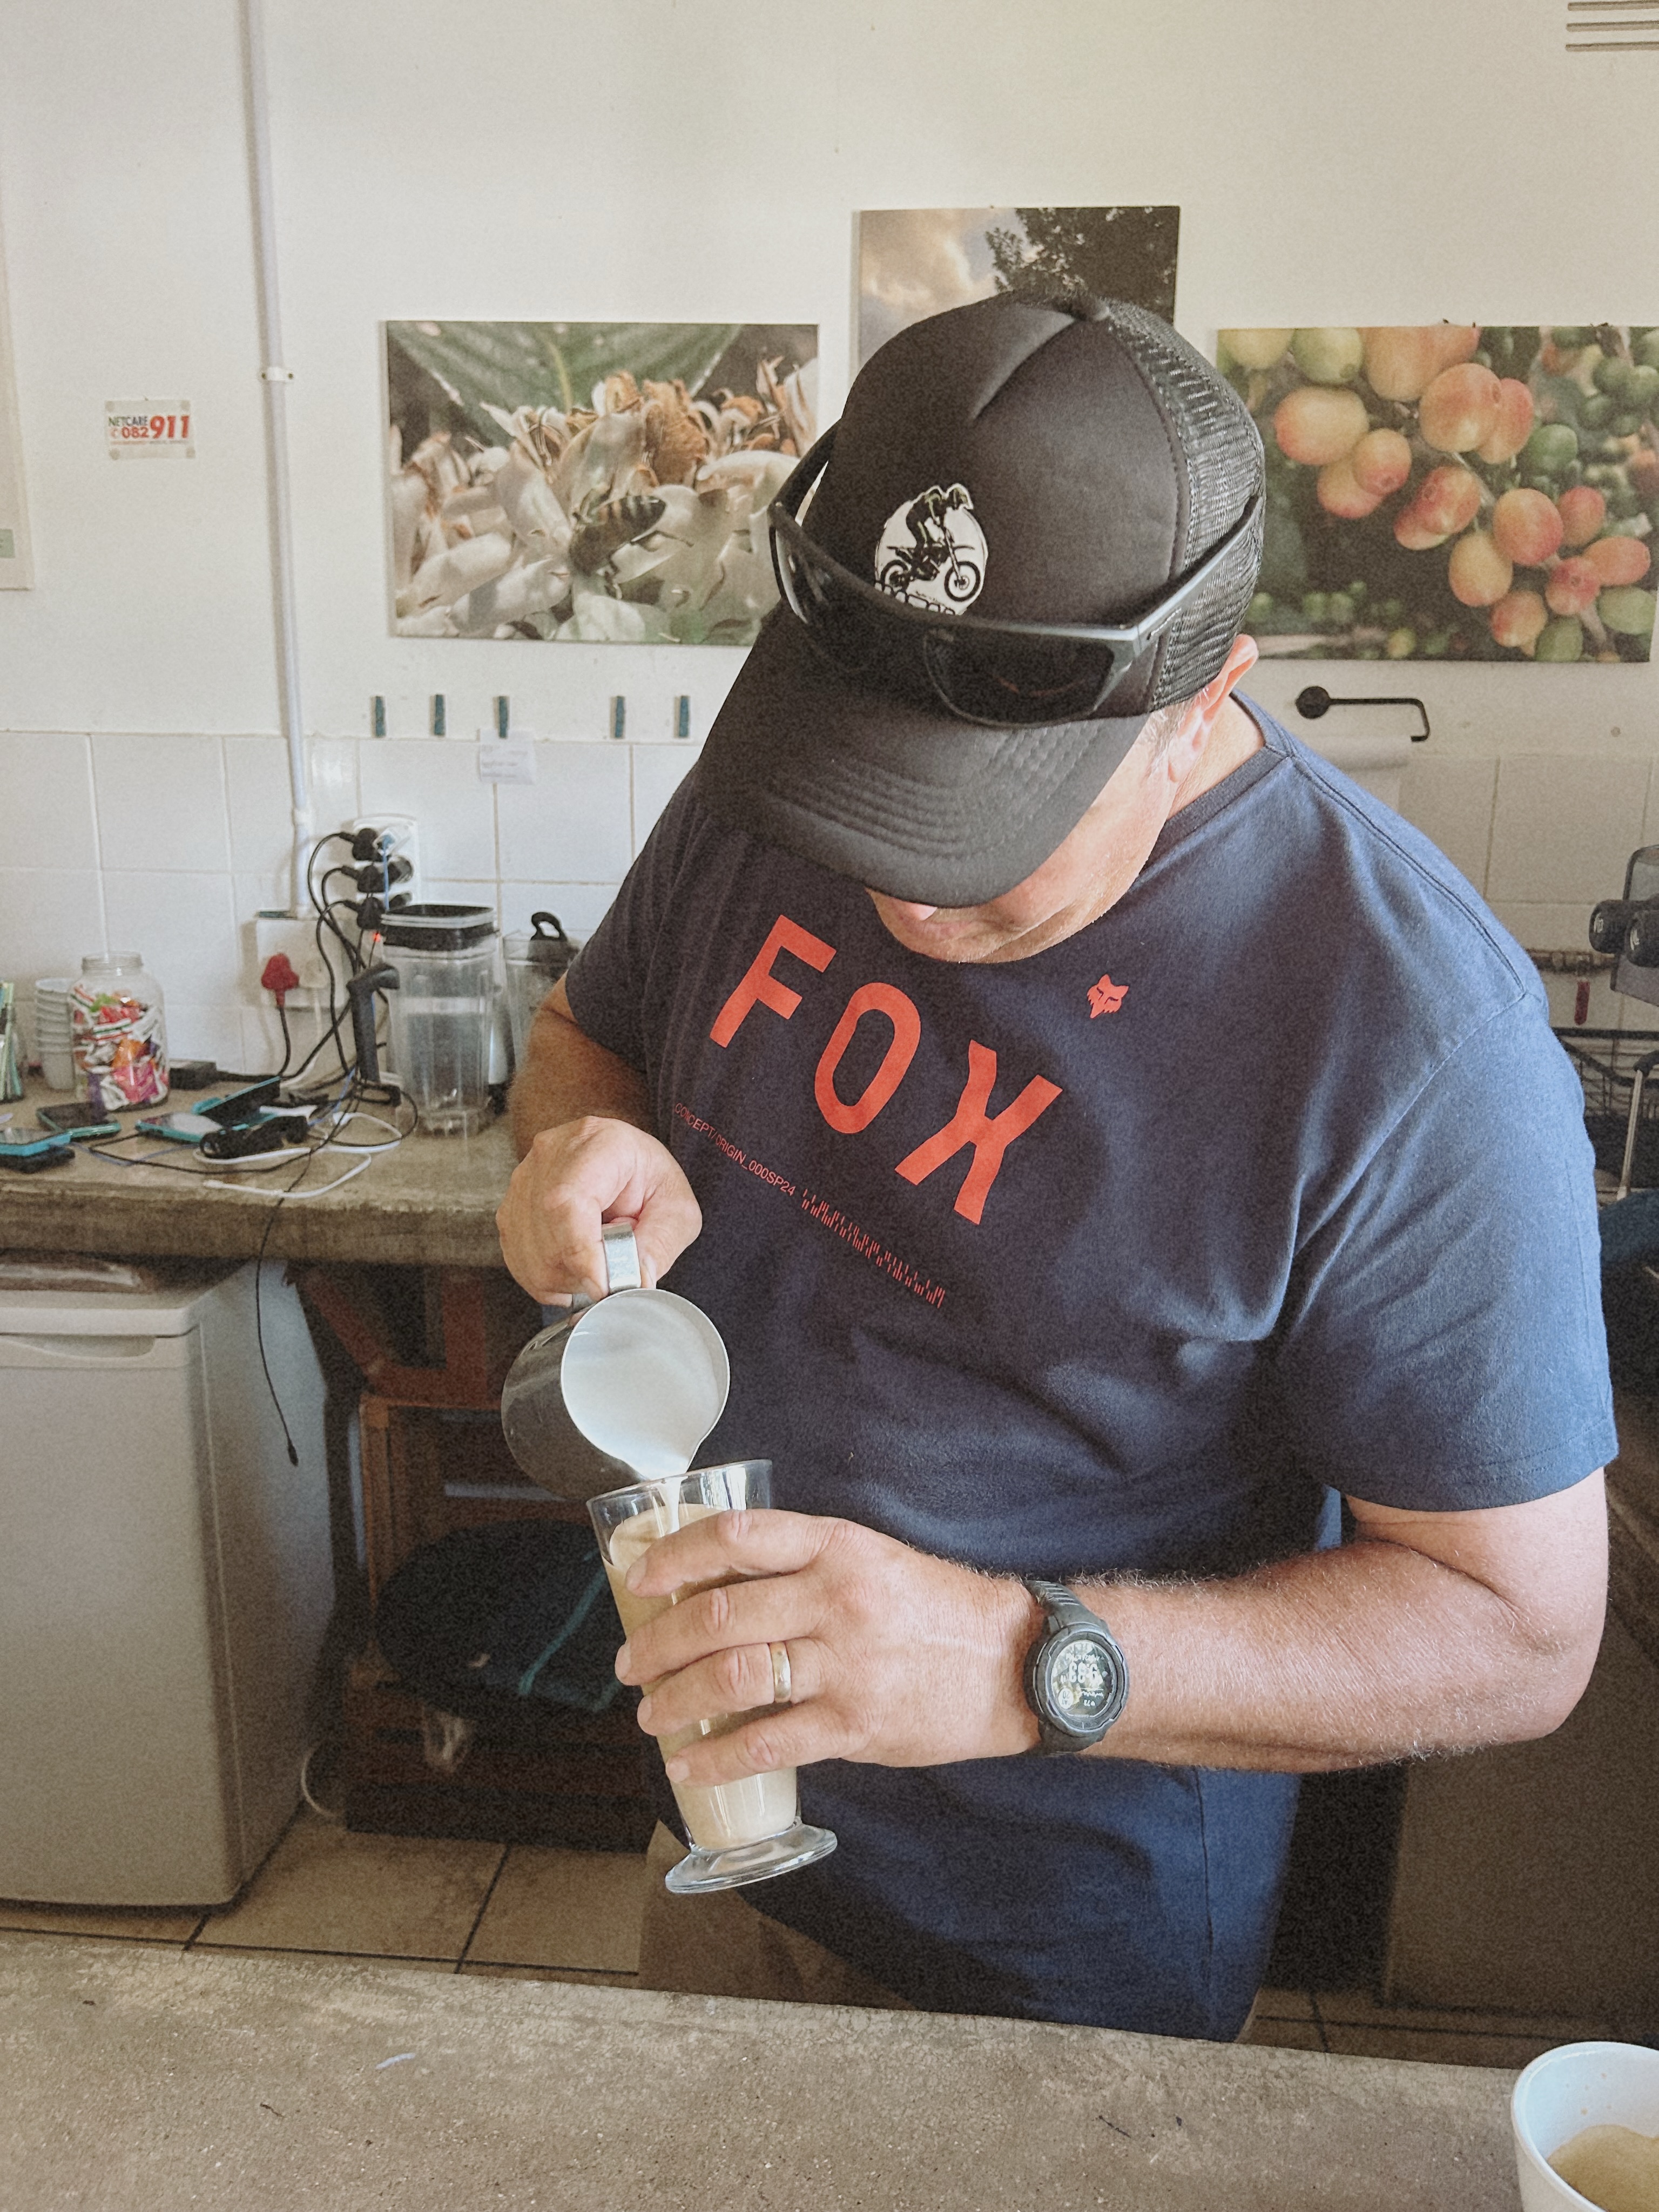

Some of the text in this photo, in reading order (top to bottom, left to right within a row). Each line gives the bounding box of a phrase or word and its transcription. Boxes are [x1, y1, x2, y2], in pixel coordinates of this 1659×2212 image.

[122, 415, 190, 439] 082 911
[710, 914, 1063, 1225] FOX
